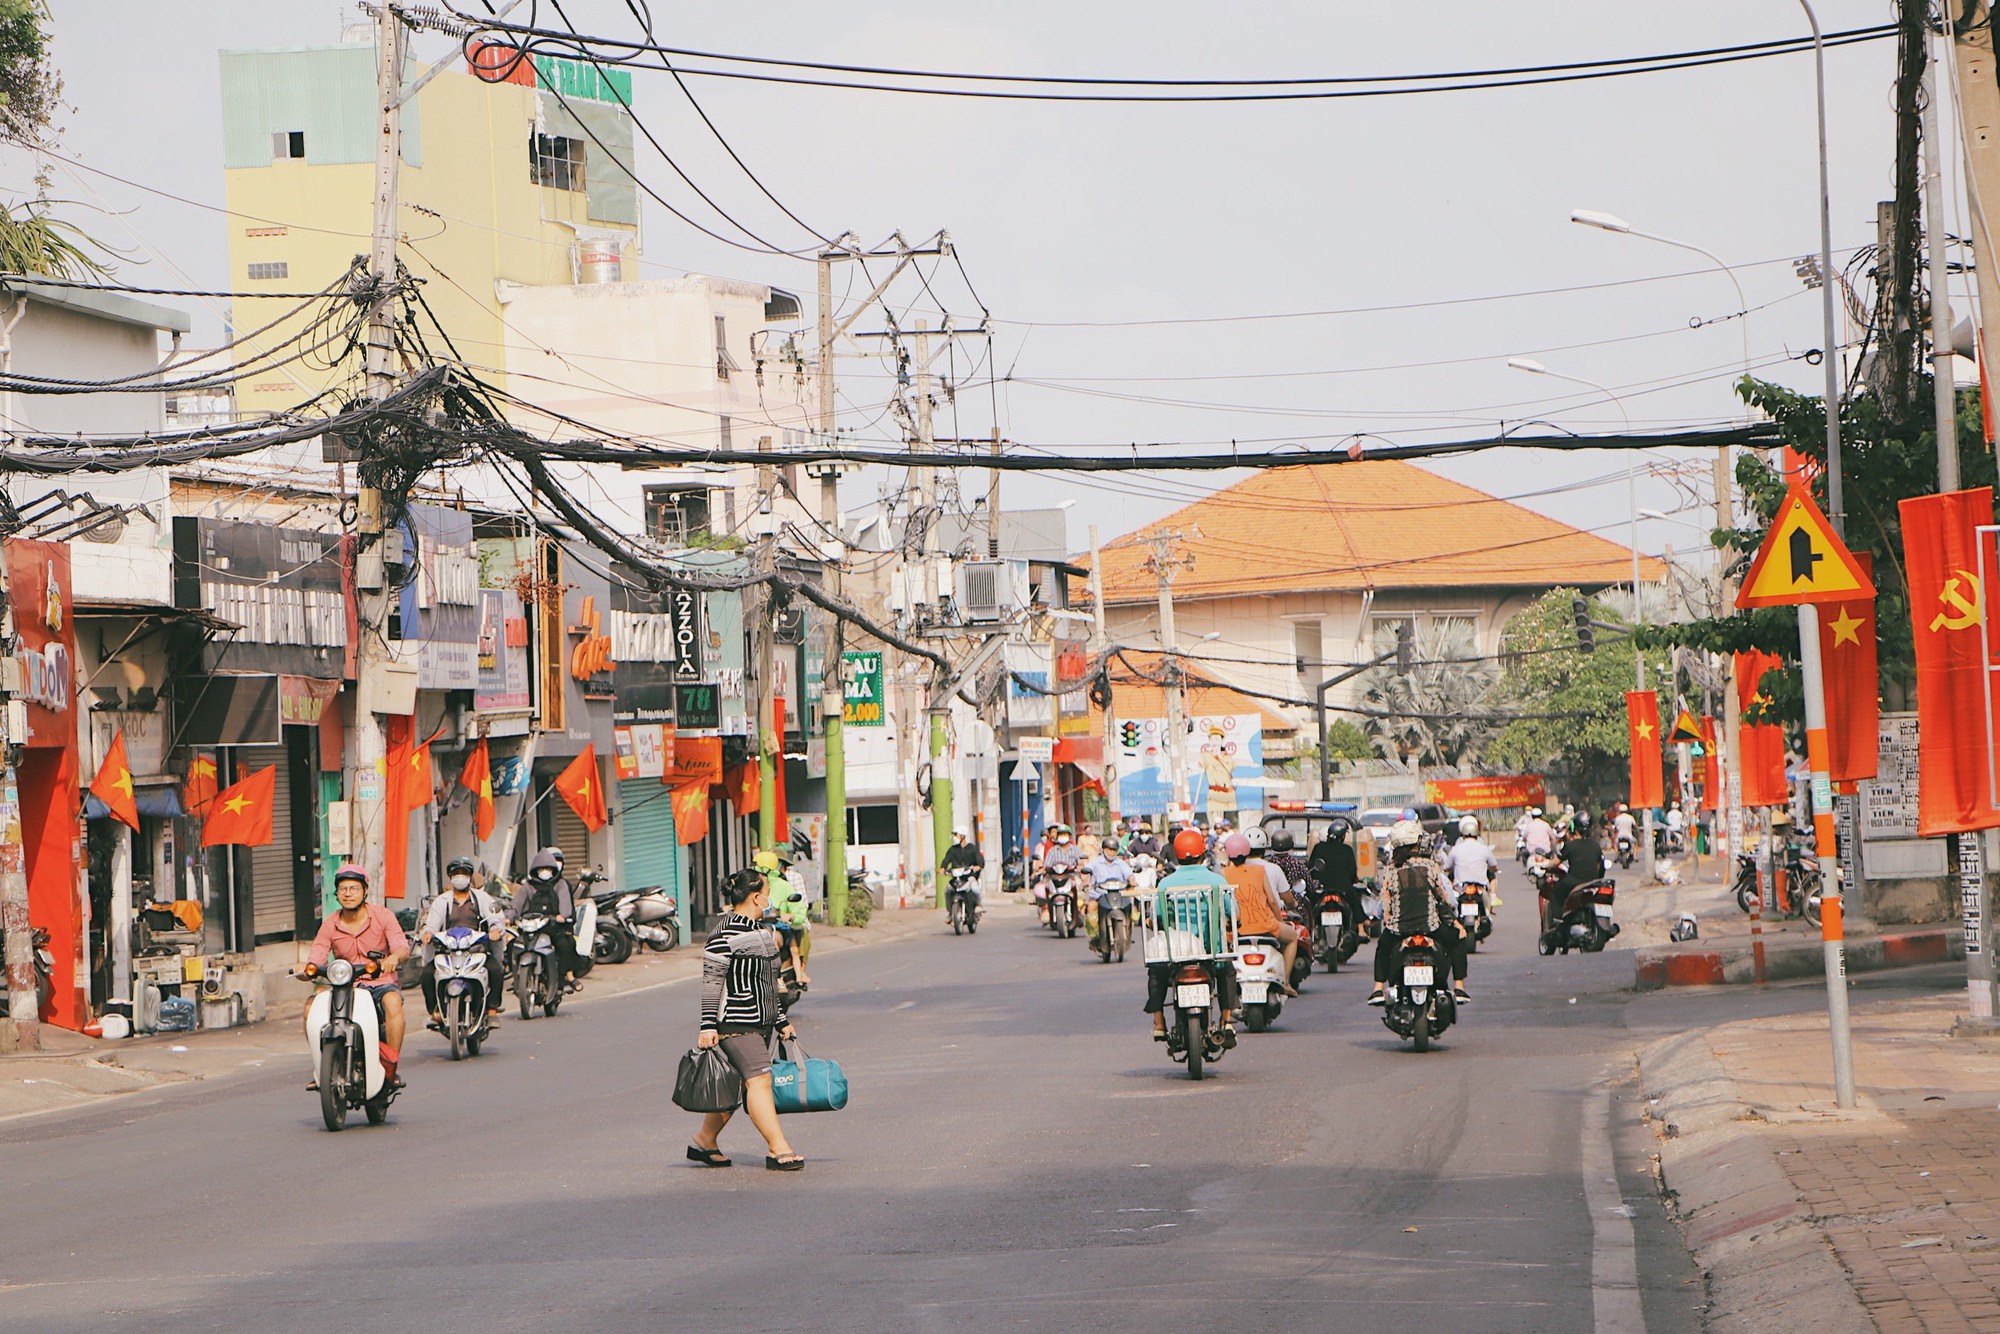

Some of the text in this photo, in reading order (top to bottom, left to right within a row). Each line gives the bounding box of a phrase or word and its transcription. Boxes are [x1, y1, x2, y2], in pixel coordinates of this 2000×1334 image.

[11, 632, 69, 712] INGDOM
[682, 687, 711, 711] 78
[844, 677, 873, 699] MÁ
[842, 703, 880, 722] 2.000
